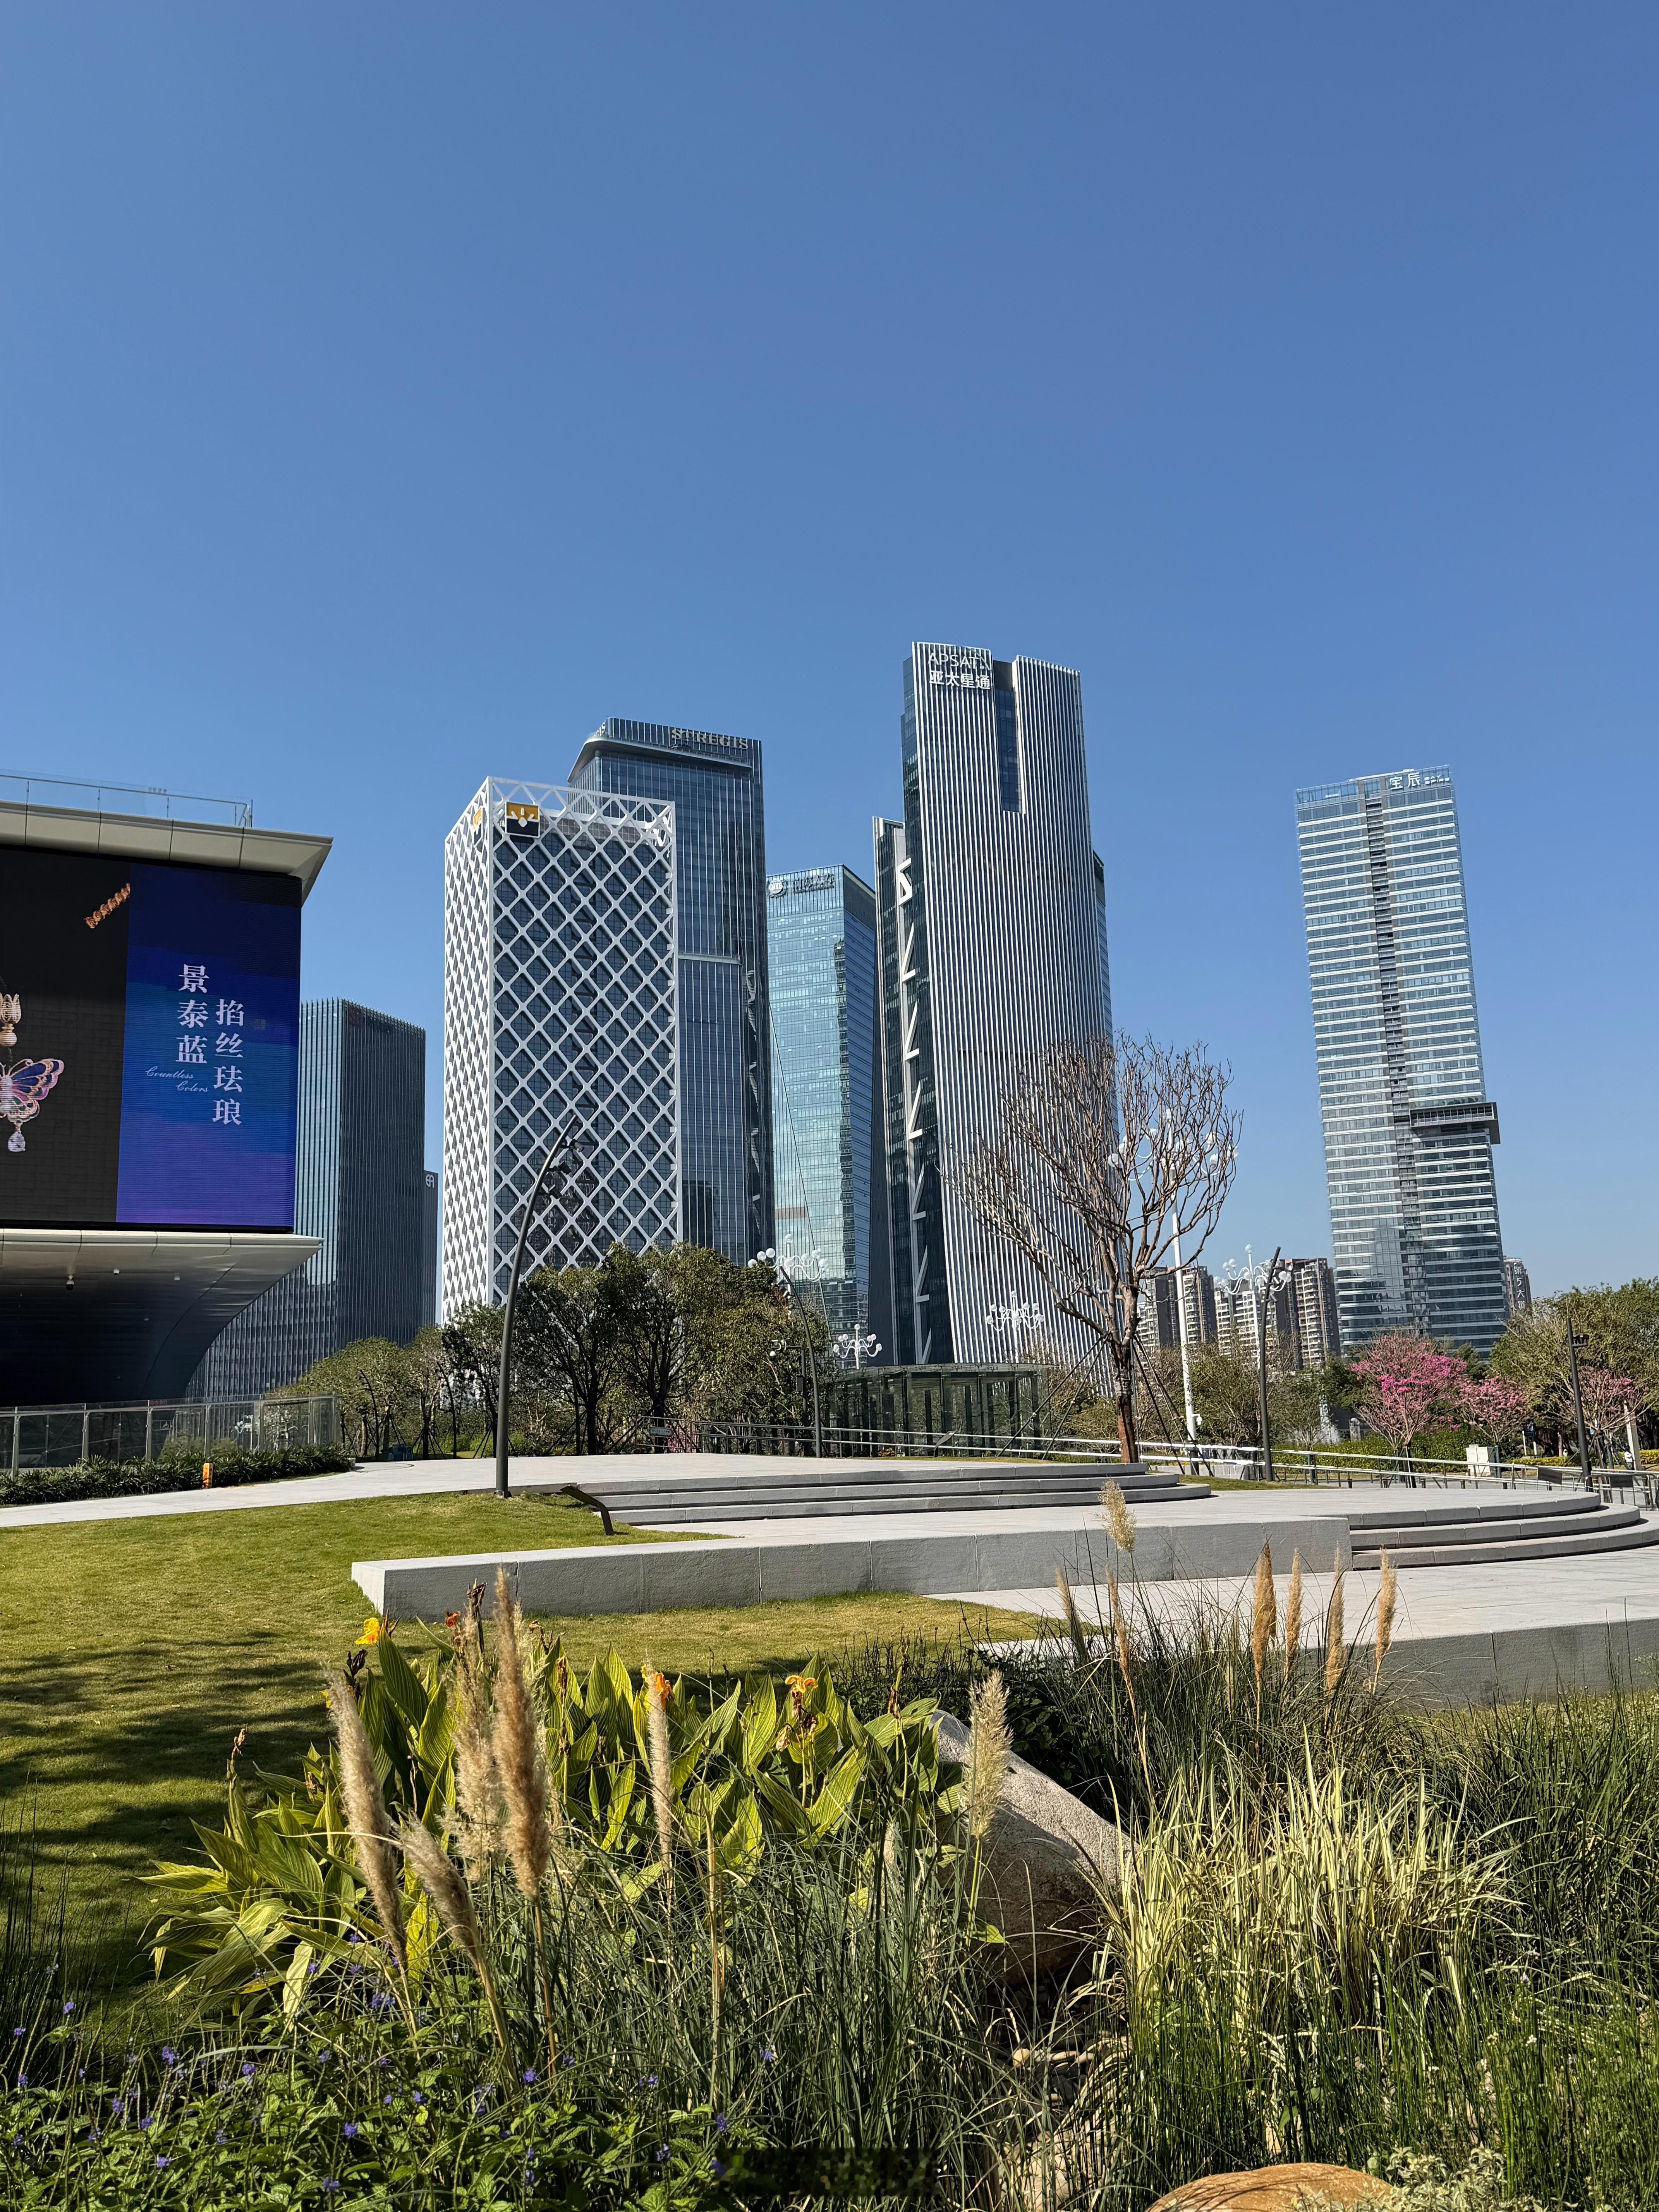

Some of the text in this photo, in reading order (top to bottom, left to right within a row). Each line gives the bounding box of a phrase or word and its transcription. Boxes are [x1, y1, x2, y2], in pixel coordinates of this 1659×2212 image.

[929, 670, 991, 690] 亚太星通
[1389, 772, 1420, 790] 宝辰
[175, 963, 210, 1064] 景泰蓝
[212, 998, 244, 1125] 掐丝珐琅
[145, 1066, 194, 1079] Countless
[176, 1080, 209, 1092] Colors
